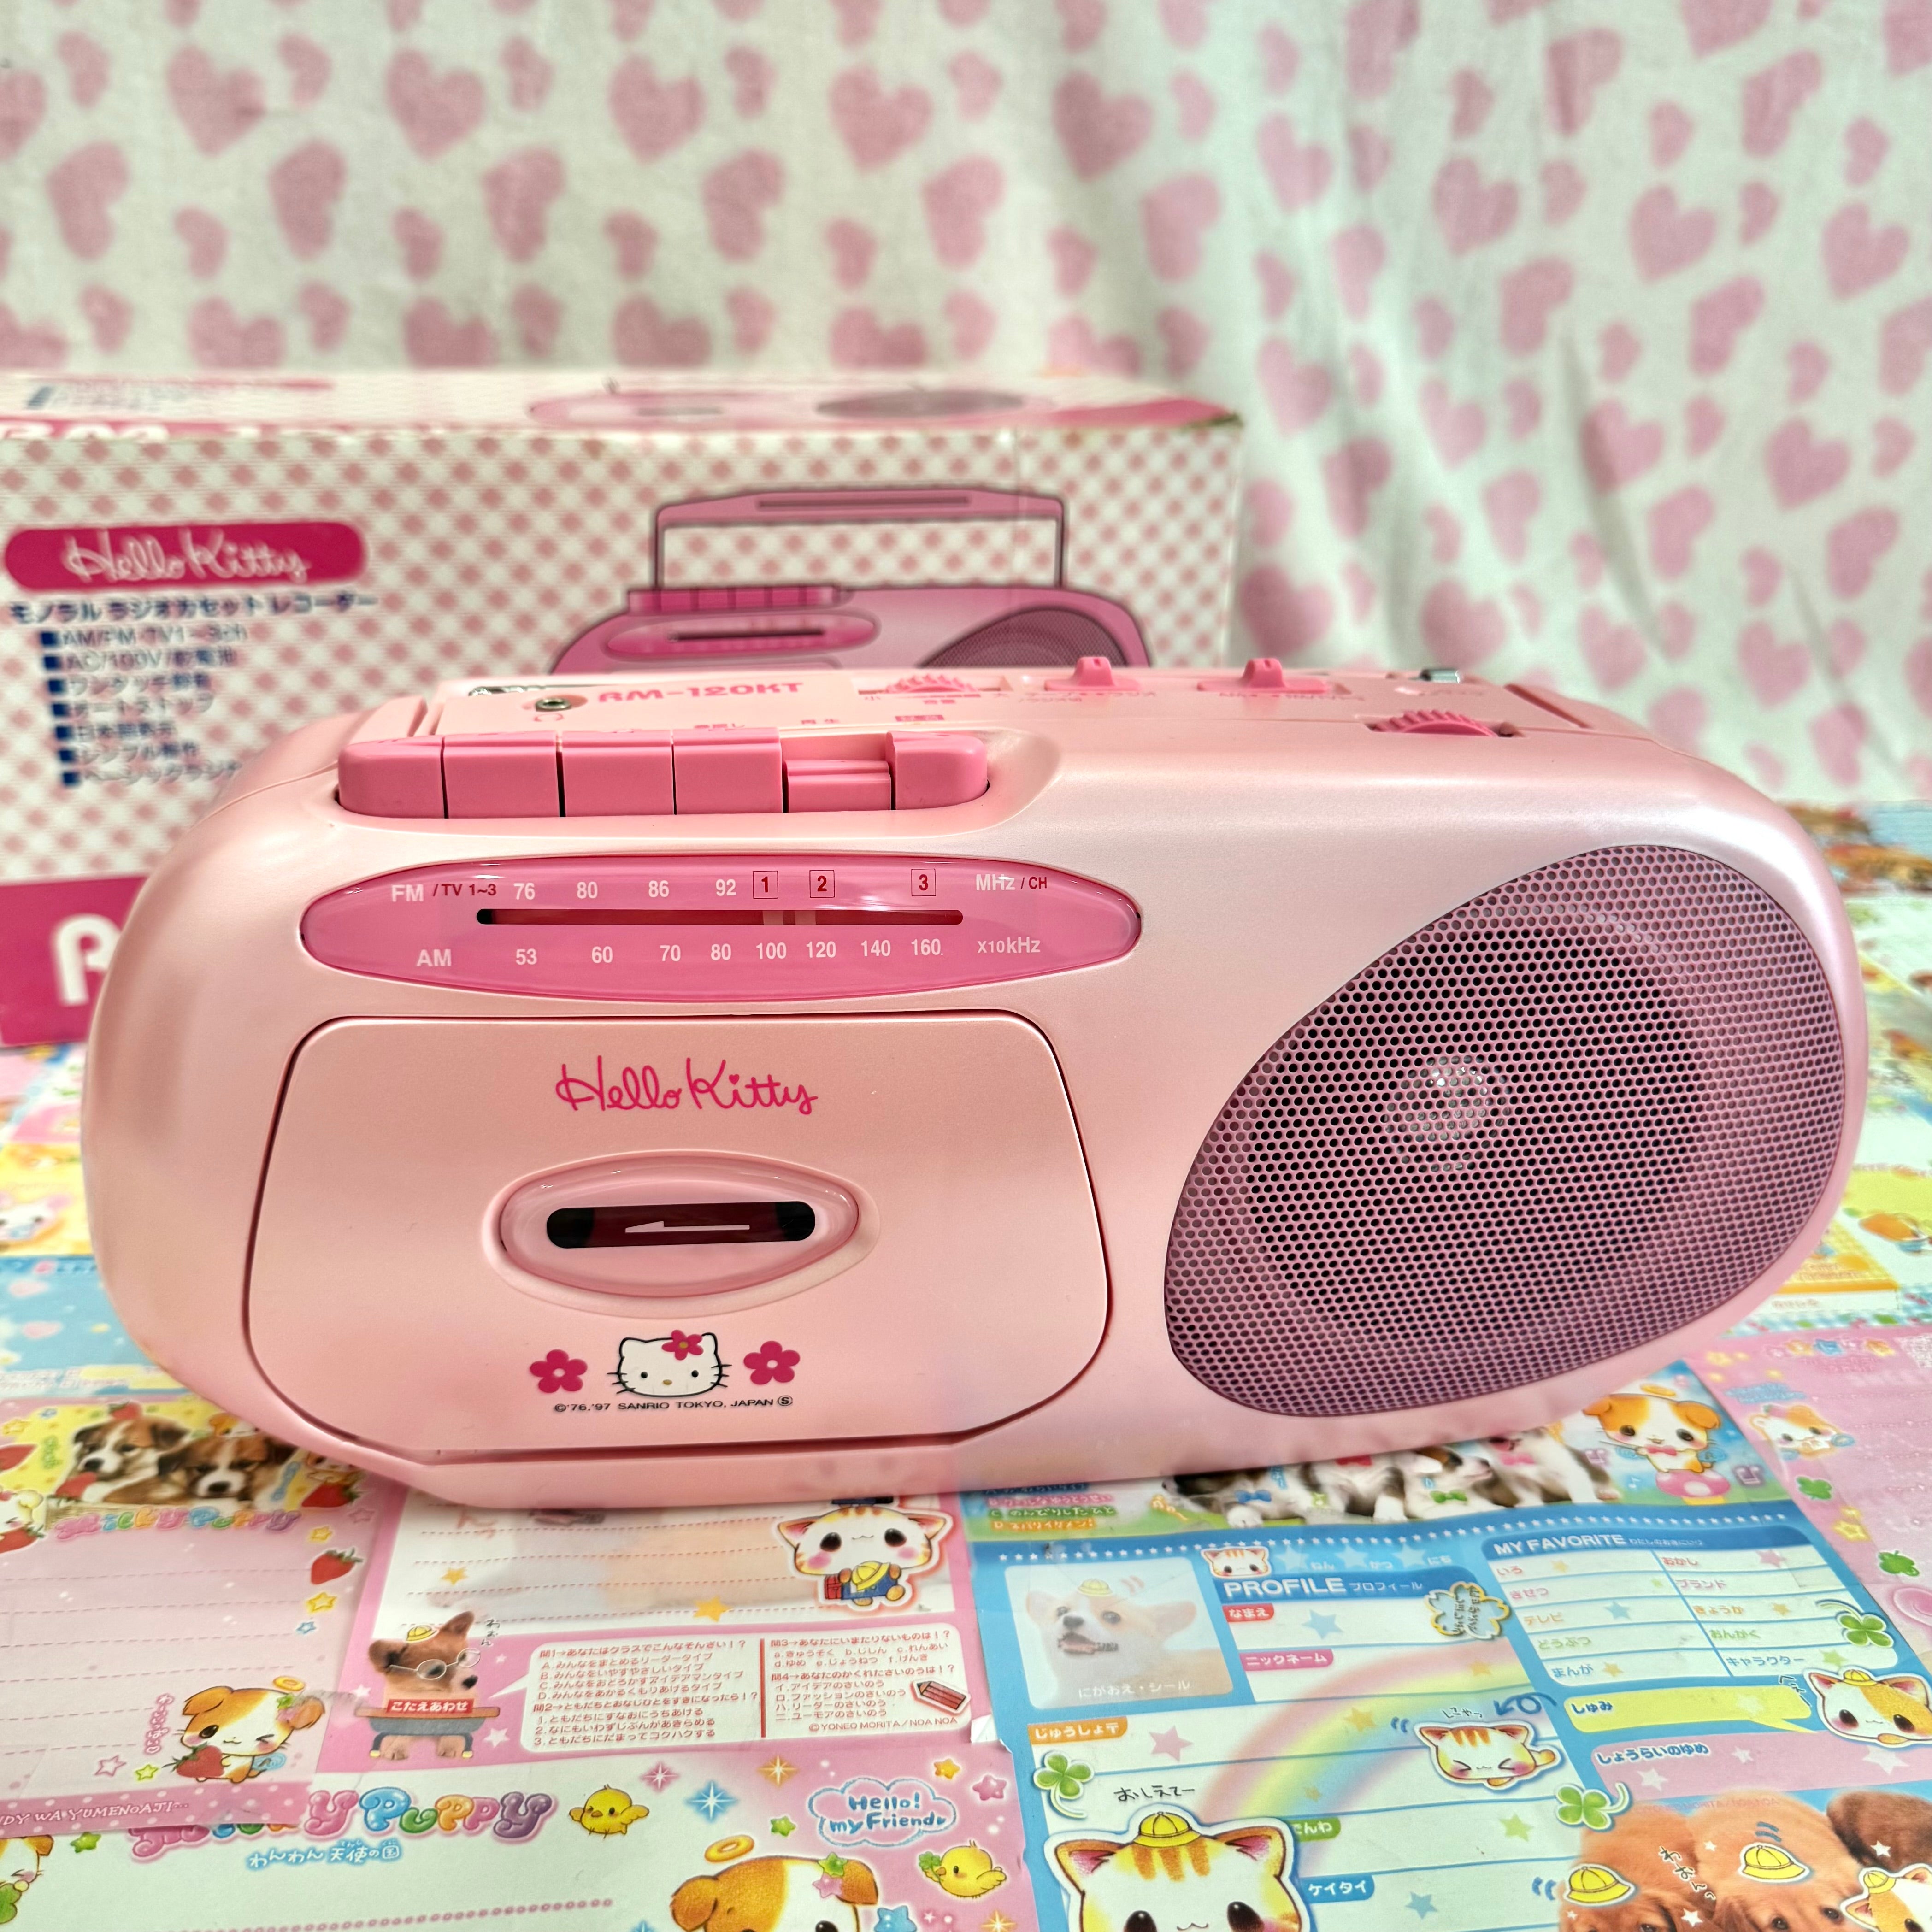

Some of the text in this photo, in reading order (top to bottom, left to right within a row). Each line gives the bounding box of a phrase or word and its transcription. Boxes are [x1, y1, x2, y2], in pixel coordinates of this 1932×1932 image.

[61, 528, 313, 584] Hello Kitty
[392, 884, 424, 902] FM
[514, 882, 536, 901] 76
[576, 881, 598, 899] 80
[648, 880, 670, 898] 86
[715, 878, 737, 896] 92
[976, 874, 1015, 891] MHz
[1029, 876, 1048, 889] CH
[417, 948, 452, 967] AM
[516, 948, 538, 966] 53
[591, 946, 613, 964] 60
[660, 944, 682, 962] 70
[710, 943, 732, 961] 80
[756, 942, 787, 960] 100
[806, 941, 837, 959] 120
[860, 939, 891, 957] 140
[555, 1054, 819, 1115] Hello Kitty
[618, 1402, 670, 1410] SANRIO
[730, 1398, 774, 1407] JAPAN
[1493, 1540, 1522, 1555] MY
[1527, 1534, 1627, 1553] FAVORITE
[1661, 1556, 1698, 1566] おかし
[1496, 1565, 1523, 1576] いろ
[1223, 1577, 1423, 1597] PROFILE プロフィール
[1675, 1579, 1726, 1590] ブランド
[1510, 1587, 1549, 1599] きせつ
[1228, 1607, 1270, 1619] なまえ
[1523, 1612, 1564, 1625] テレビ
[1709, 1629, 1761, 1639] おんがく
[1538, 1636, 1592, 1650] どうぶつ
[1245, 1652, 1328, 1666] ニックネーム
[1725, 1655, 1805, 1667] キャラクター
[1552, 1664, 1594, 1678] まんが
[391, 1701, 469, 1712] こたえあわせ
[1571, 1700, 1613, 1714] しゅみ
[935, 1716, 958, 1725] NOA
[1597, 1743, 1709, 1765] しょうらいのゆめ
[1113, 1785, 1195, 1802] おしえてー
[848, 1792, 921, 1810] Hello!
[35, 1809, 63, 1823] WA
[830, 1812, 936, 1834] my Friend
[249, 1845, 400, 1867] わんわん 天使の国
[1308, 1879, 1367, 1896] ケイタイ
